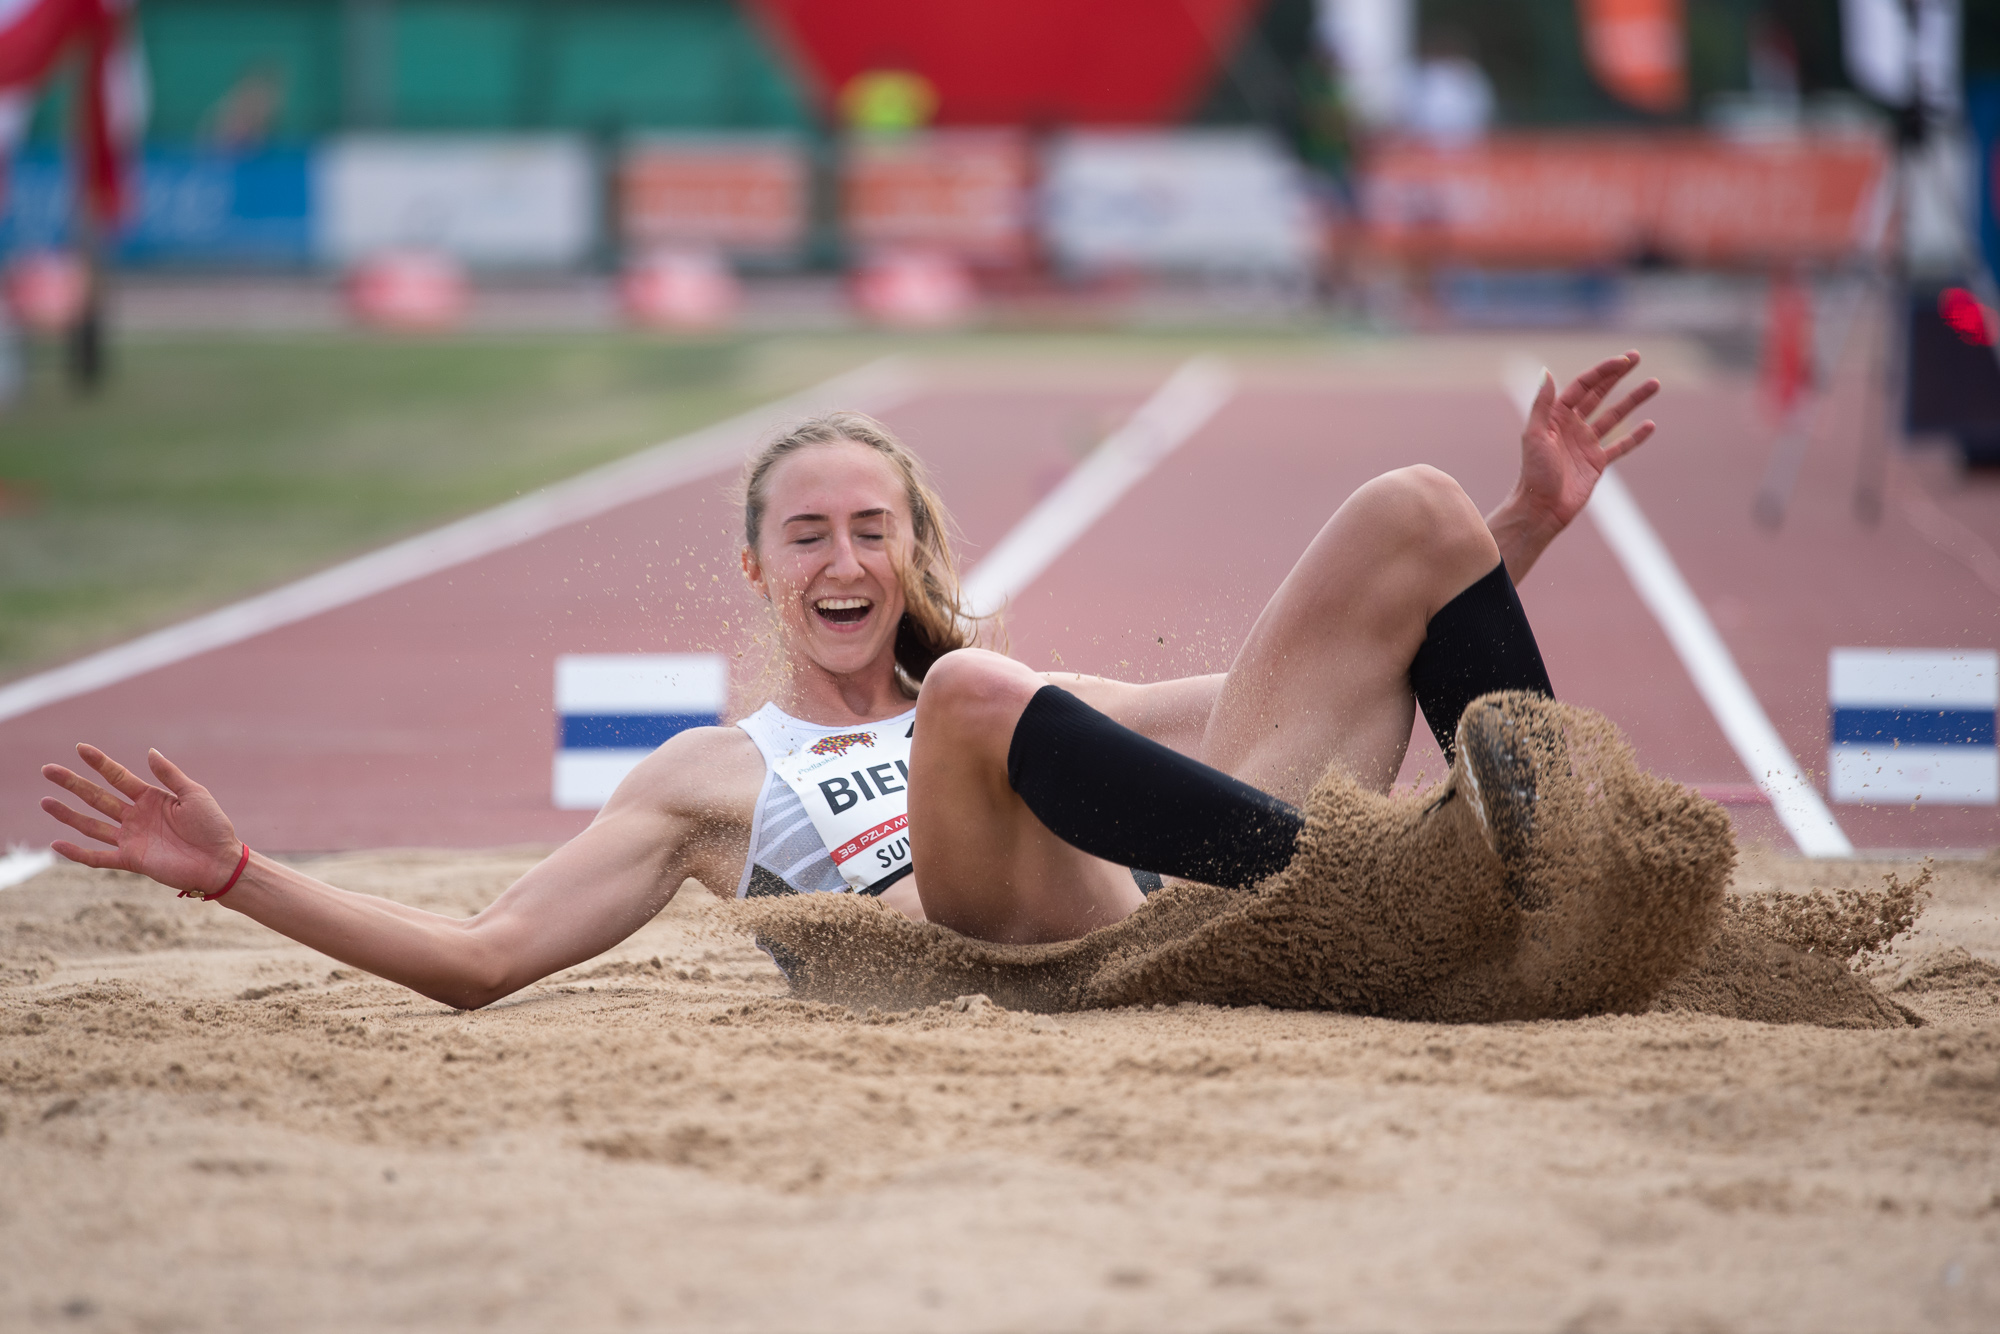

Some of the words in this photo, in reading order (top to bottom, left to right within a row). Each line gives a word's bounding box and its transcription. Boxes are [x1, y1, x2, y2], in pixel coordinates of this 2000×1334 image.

[798, 755, 838, 775] Podlaskie
[838, 843, 860, 859] 38.
[860, 825, 893, 846] PZLA
